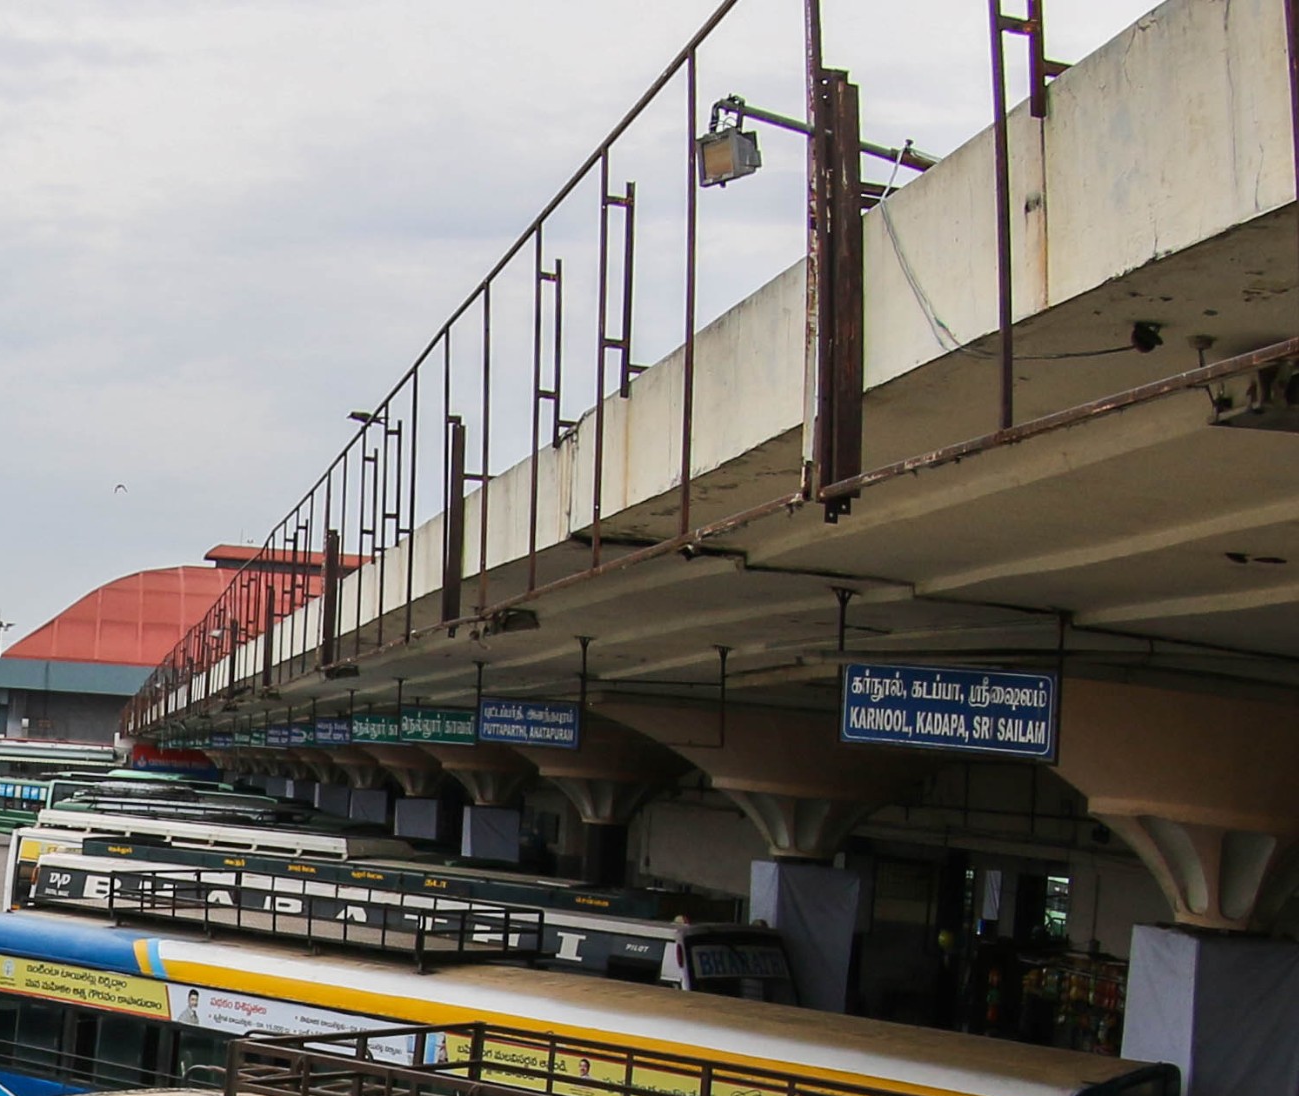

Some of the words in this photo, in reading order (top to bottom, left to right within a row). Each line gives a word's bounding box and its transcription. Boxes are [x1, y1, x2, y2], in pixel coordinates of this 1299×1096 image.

[850, 706, 912, 737] KARNOOL,
[916, 711, 969, 742] KADAPA,
[972, 716, 994, 739] SRI
[997, 717, 1045, 744] SAILAM
[625, 943, 649, 953] PILOT
